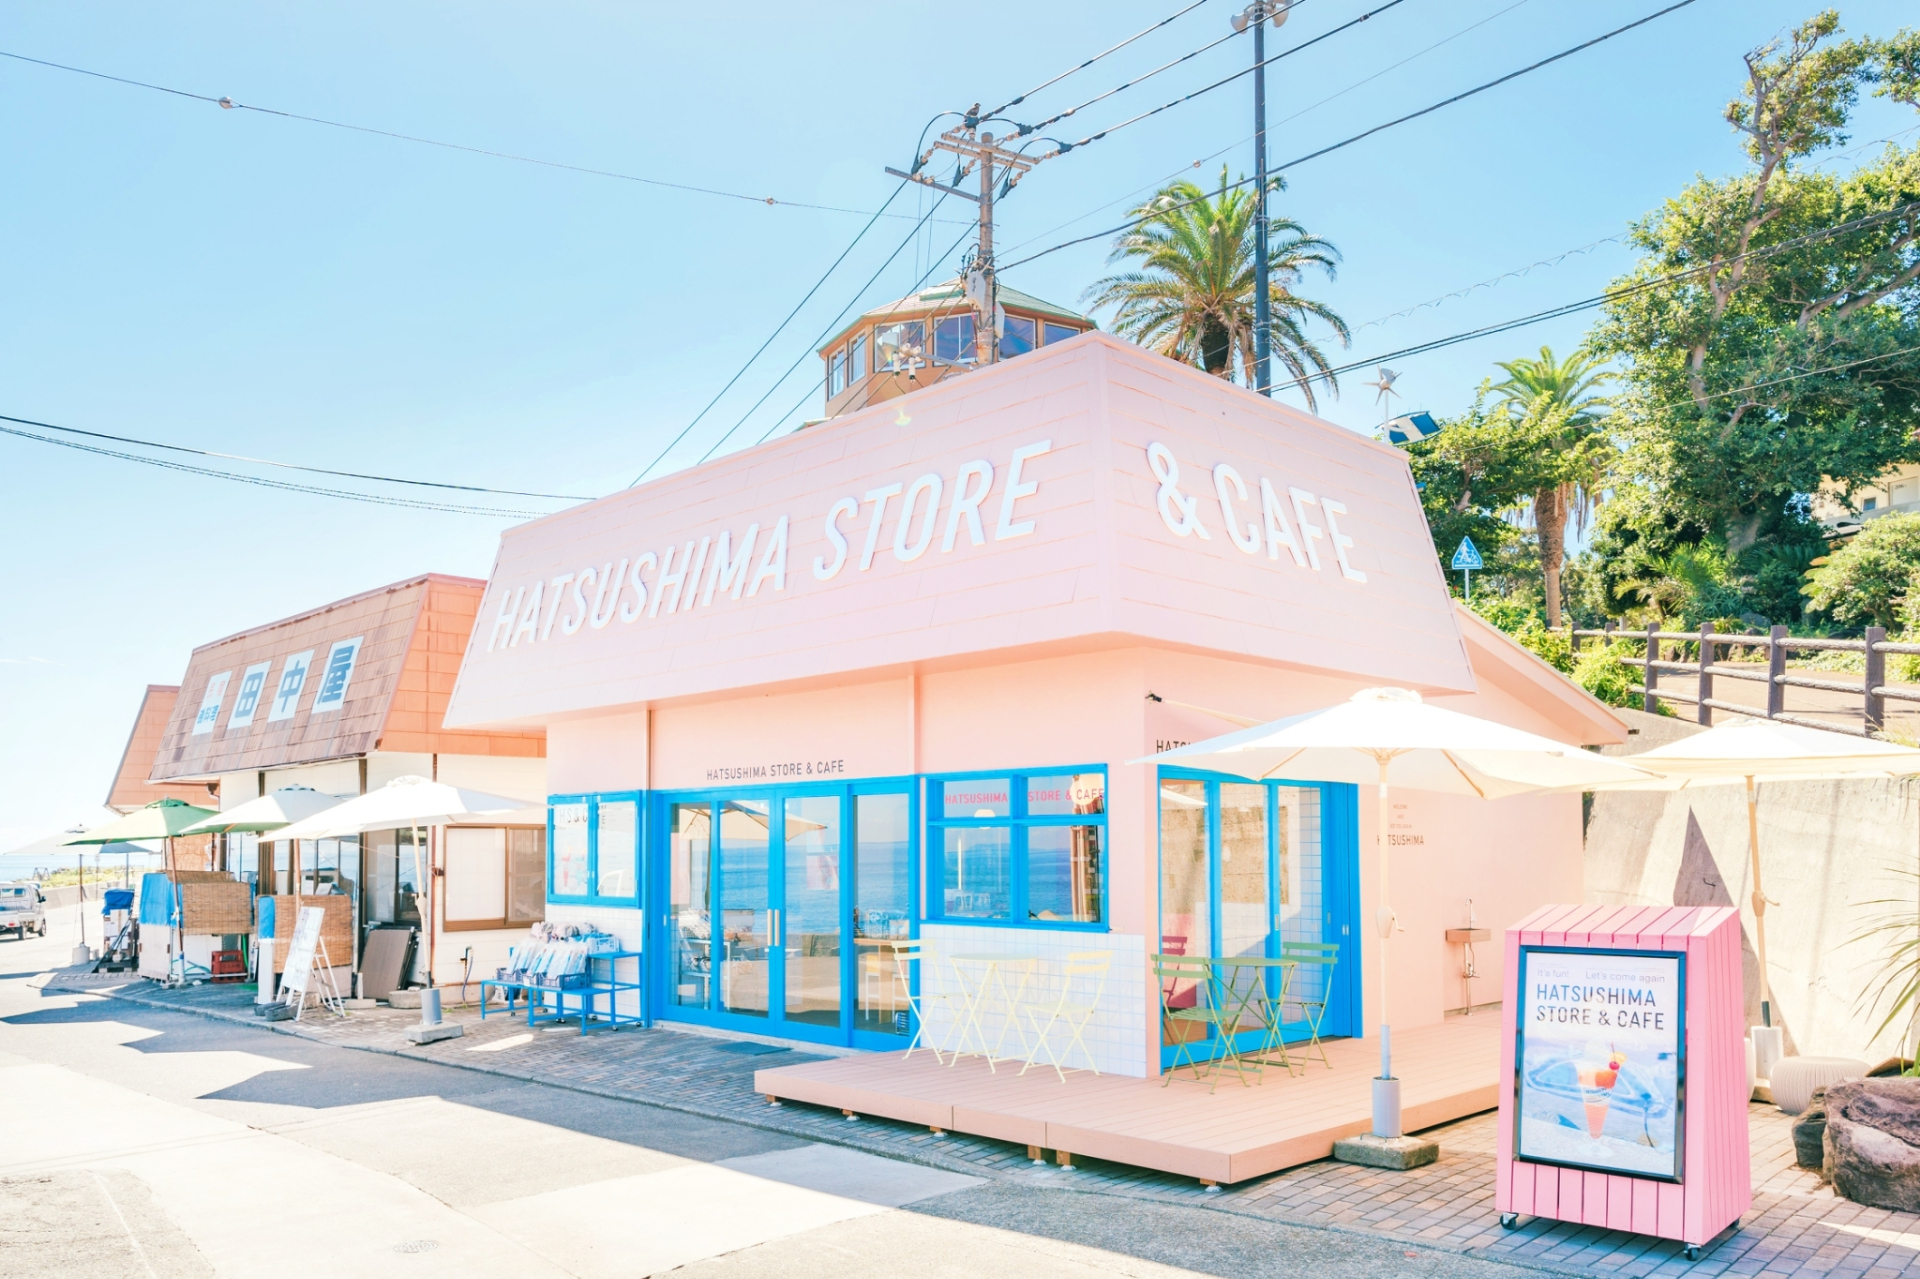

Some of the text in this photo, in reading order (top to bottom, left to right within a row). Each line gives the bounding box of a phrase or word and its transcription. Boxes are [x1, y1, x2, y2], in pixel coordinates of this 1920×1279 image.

[1146, 441, 1368, 584] & CAFE
[487, 439, 1053, 652] HATSUSHIMA STORE
[706, 759, 844, 780] HATSUSHIMA STORE & CAFE
[945, 787, 1104, 804] HATSUSHIMA STORE & CAFE
[1537, 968, 1665, 984] It's fun! Let's come again
[1536, 983, 1657, 1007] HATSUSHIMA
[1536, 1005, 1665, 1031] STORE & CAFE
